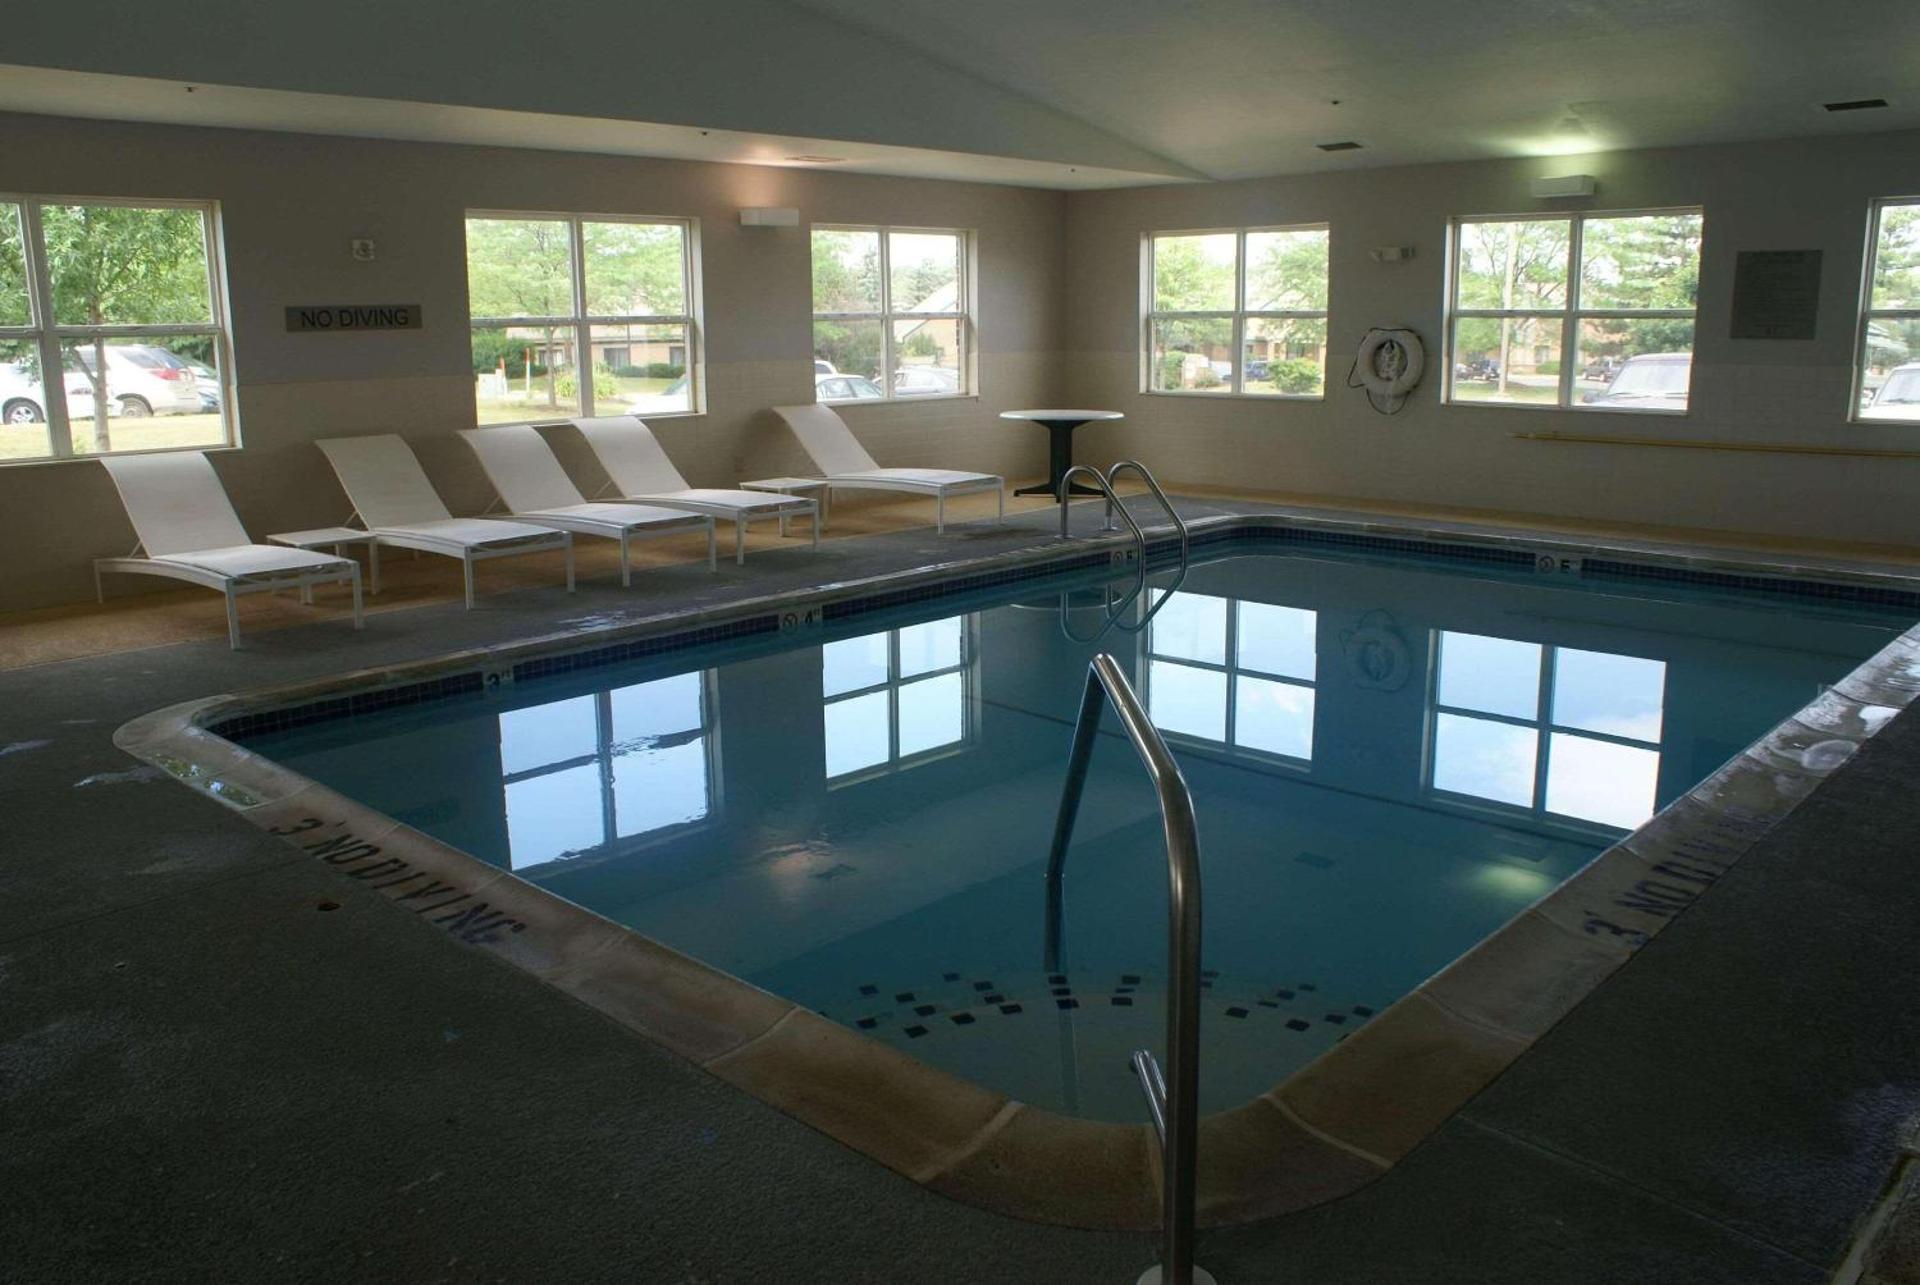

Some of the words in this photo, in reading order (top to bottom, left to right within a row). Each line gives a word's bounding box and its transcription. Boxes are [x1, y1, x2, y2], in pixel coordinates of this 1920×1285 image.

[301, 309, 333, 329] NO
[338, 307, 409, 328] DIVING
[303, 832, 381, 865] NO
[1614, 879, 1697, 918] NO
